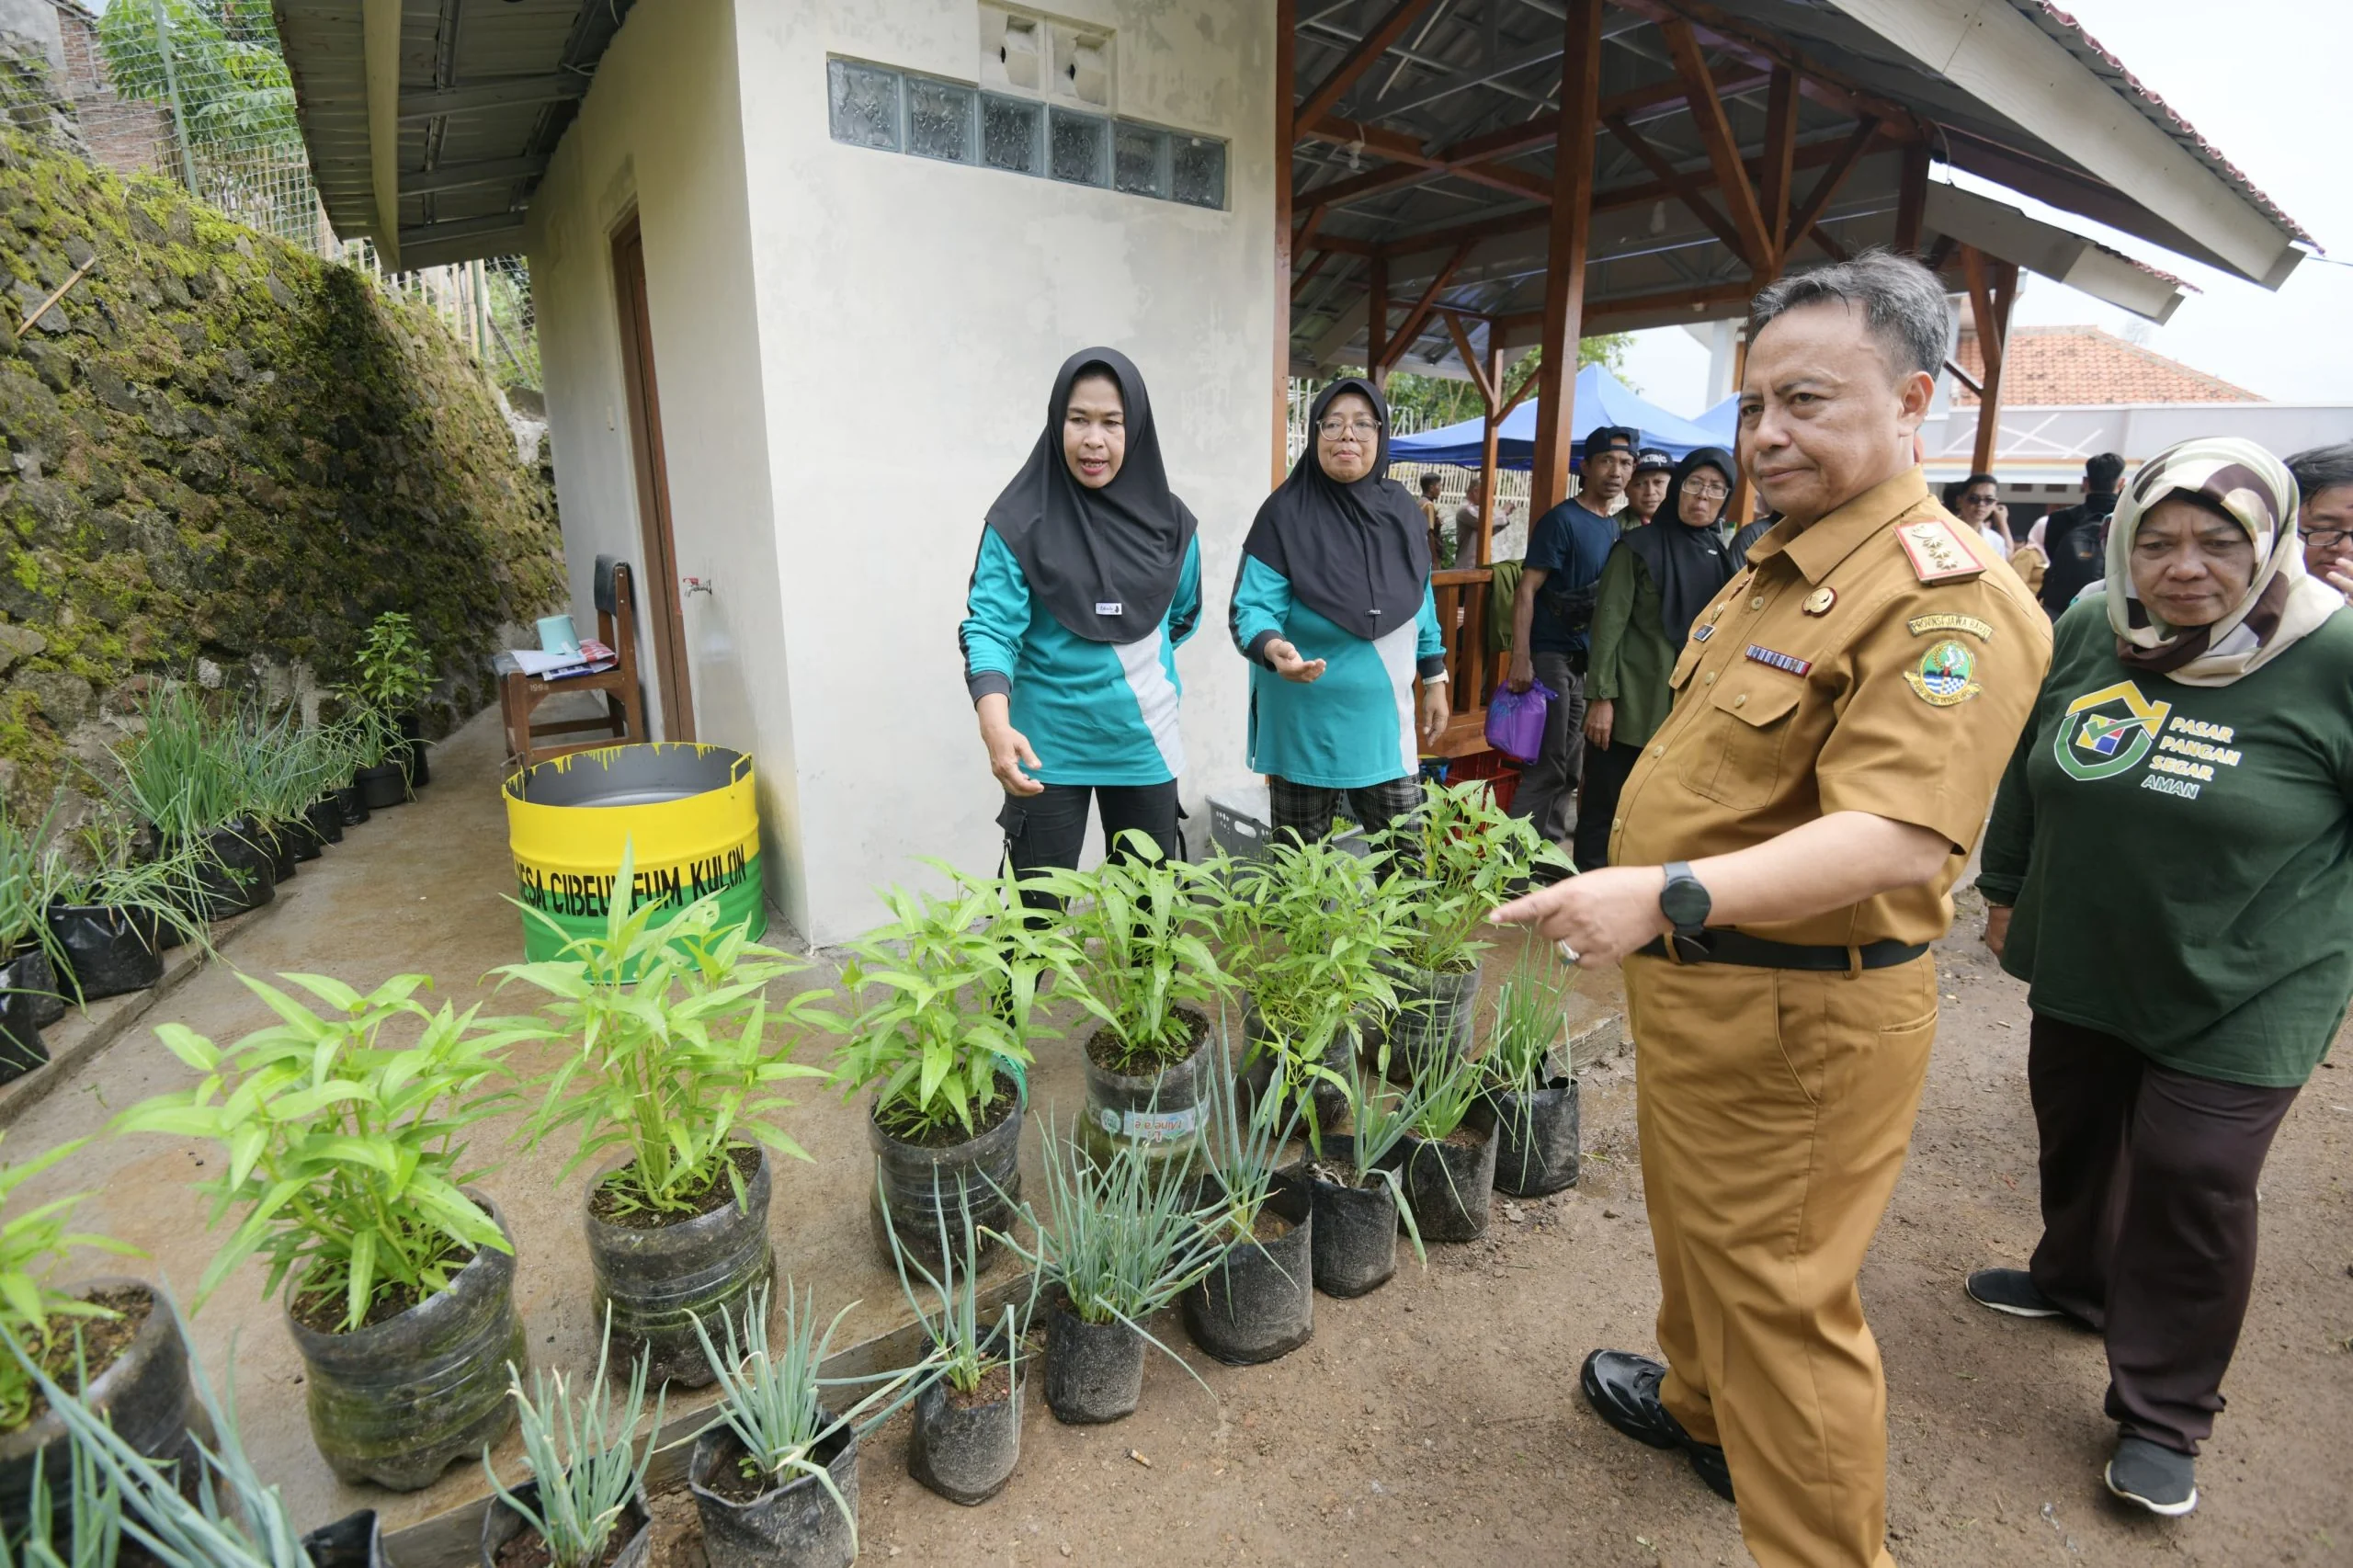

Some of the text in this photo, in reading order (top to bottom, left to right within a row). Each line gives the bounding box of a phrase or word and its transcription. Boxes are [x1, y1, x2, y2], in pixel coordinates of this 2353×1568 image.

[2169, 717, 2234, 744] PASAR
[2158, 735, 2242, 767] PANGAN
[2148, 755, 2214, 782] SEGAR
[2141, 774, 2200, 800] AMAN
[550, 867, 683, 917] CIBEUEUM
[689, 843, 747, 902] KULON
[1134, 1119, 1182, 1131] Mineae
